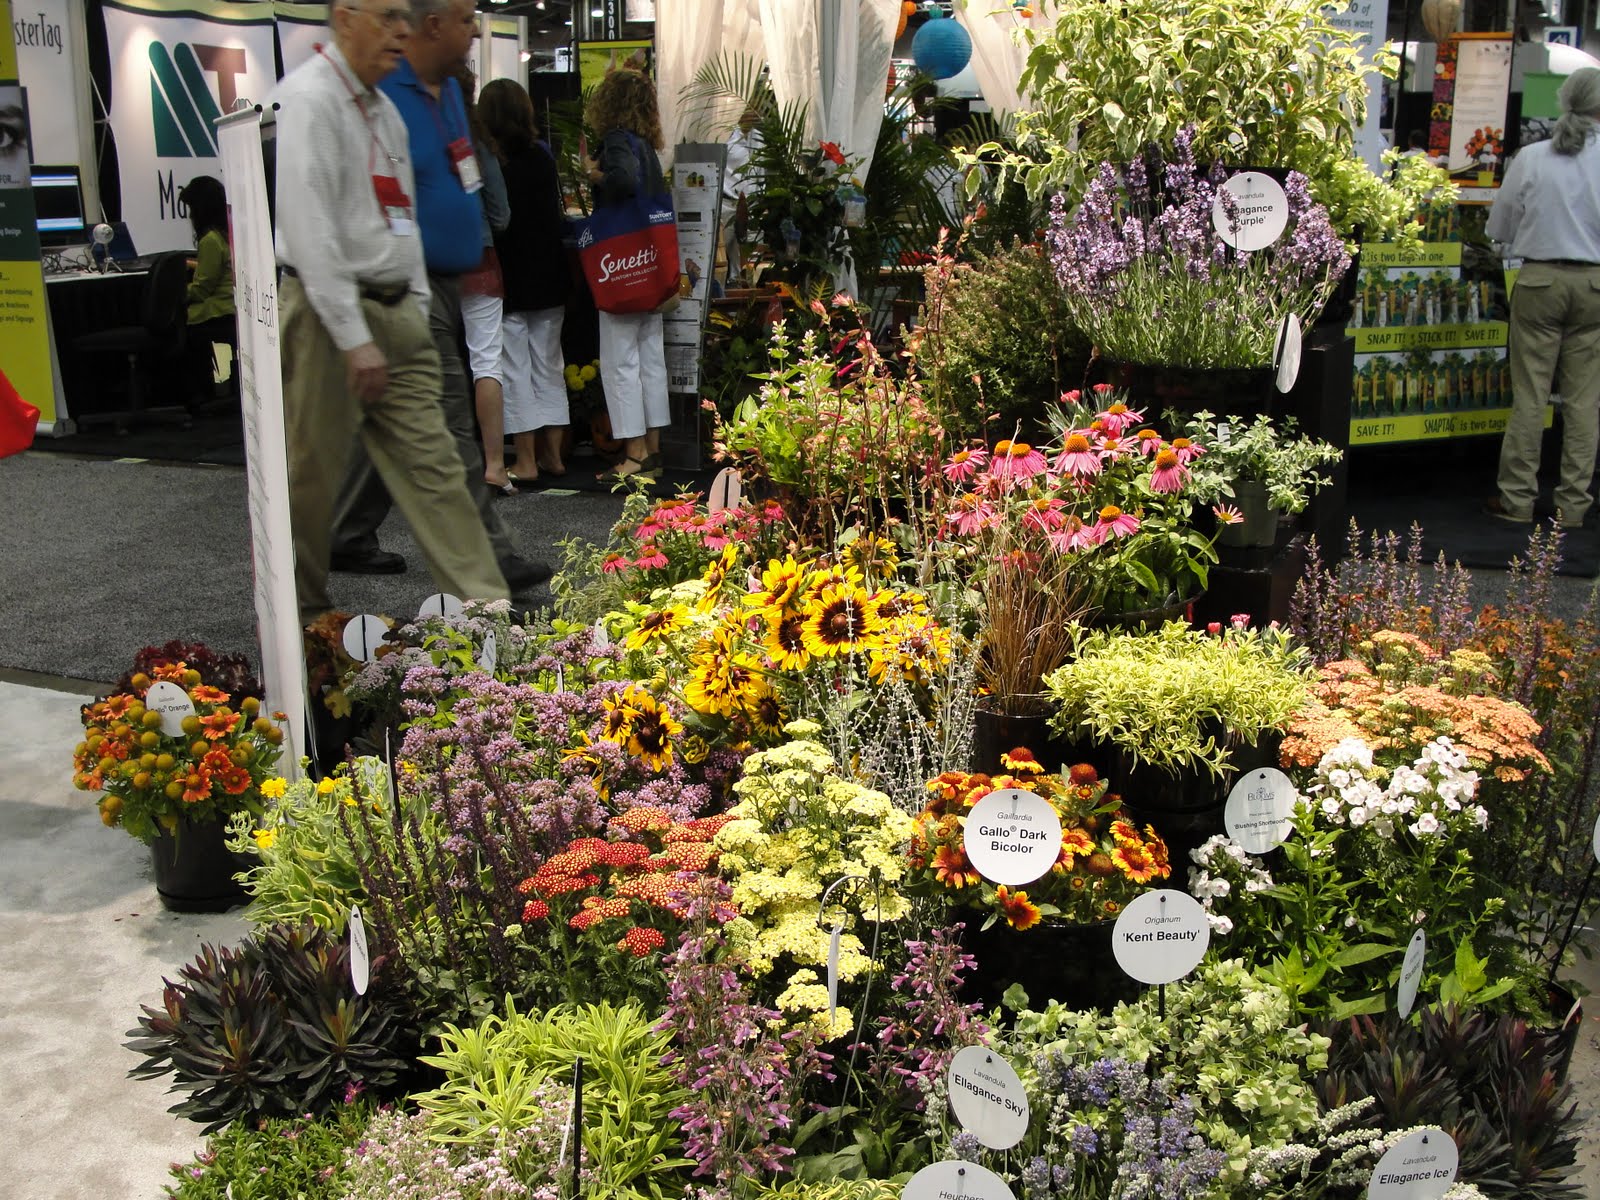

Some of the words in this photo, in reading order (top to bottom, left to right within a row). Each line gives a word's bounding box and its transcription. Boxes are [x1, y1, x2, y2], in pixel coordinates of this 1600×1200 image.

[1361, 4, 1372, 16] of
[1326, 17, 1352, 27] eners
[1354, 20, 1374, 29] want
[14, 12, 64, 55] sterTag
[1237, 192, 1265, 200] avandula
[1236, 205, 1274, 216] agance
[1381, 252, 1395, 262] two
[1429, 253, 1444, 262] one
[598, 244, 658, 283] Senetti
[1367, 334, 1391, 345] SNAP
[1393, 332, 1406, 344] IT!
[1417, 331, 1443, 344] STICK
[1444, 330, 1457, 342] IT!
[1465, 329, 1486, 341] SAVE
[1487, 328, 1500, 340] IT!
[1356, 424, 1379, 438] SAVE
[1382, 423, 1395, 436] IT!
[1460, 420, 1468, 431] is
[1471, 420, 1486, 431] two
[1488, 418, 1507, 431] tags
[168, 703, 190, 712] Orange
[997, 811, 1033, 822] Gaillardia
[1019, 829, 1048, 841] Dark
[991, 840, 1034, 854] Bicolor
[1144, 916, 1182, 926] Origanum
[1122, 932, 1153, 943] 'Kent
[1156, 929, 1200, 942] Beauty'
[973, 1067, 1007, 1090] Lavandula
[952, 1072, 1003, 1106] 'Ellagance
[1004, 1098, 1027, 1118] Sky'
[1402, 1154, 1437, 1165] Lavandula
[1378, 1170, 1431, 1185] 'Ellagance
[1433, 1167, 1453, 1179] Ice'
